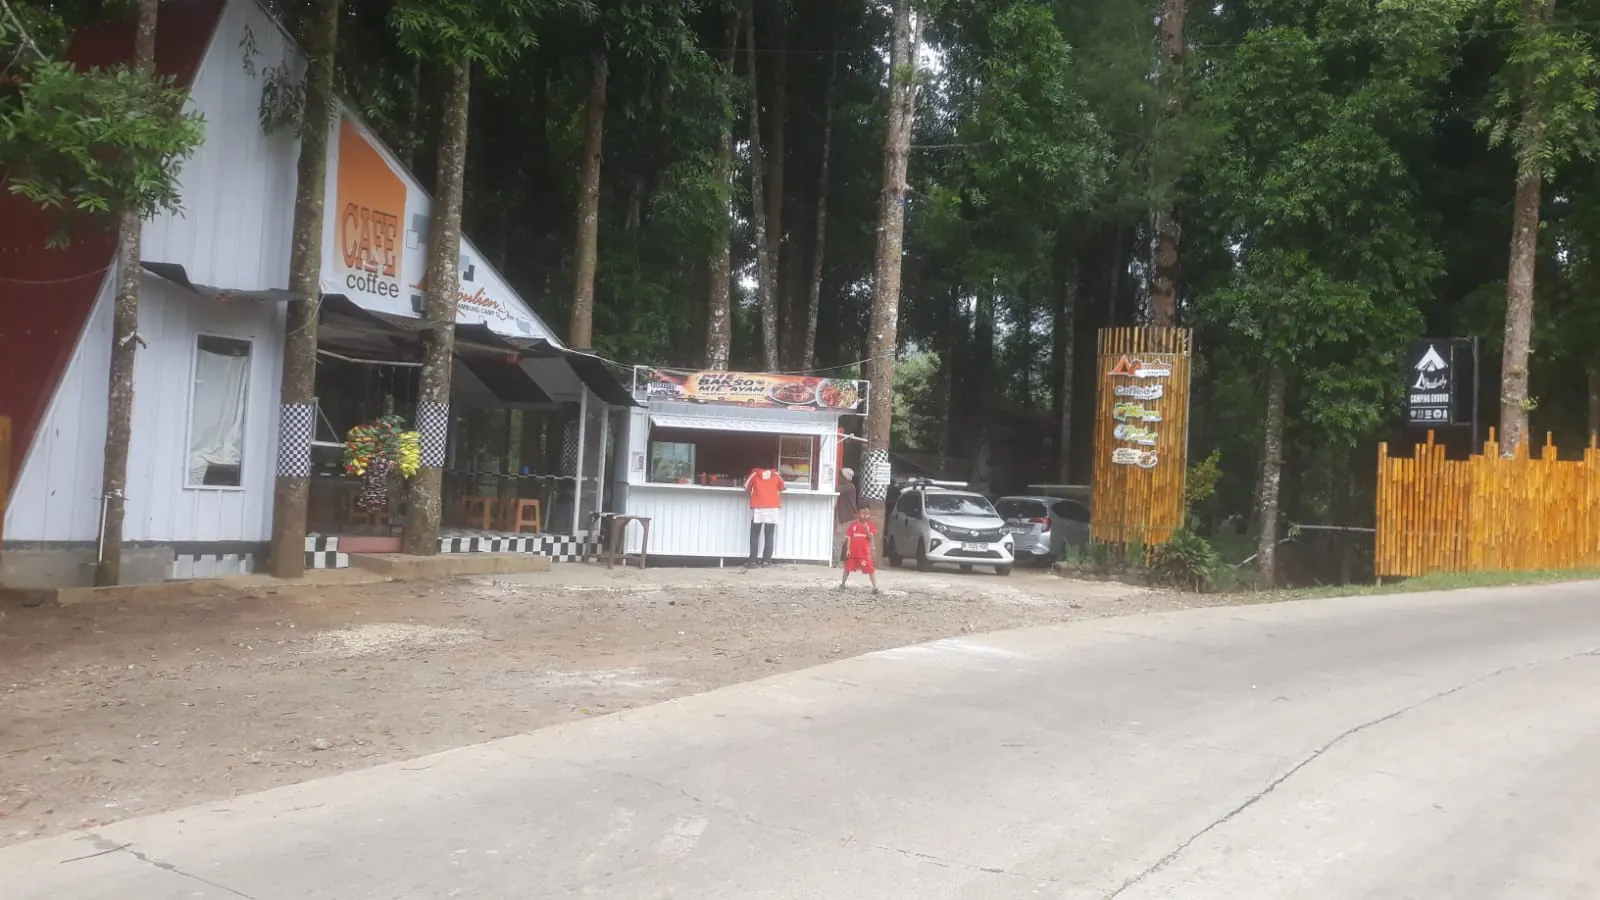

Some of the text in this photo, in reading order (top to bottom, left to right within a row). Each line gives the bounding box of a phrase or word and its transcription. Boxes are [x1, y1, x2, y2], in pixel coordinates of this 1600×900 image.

[342, 202, 397, 277] CAFE
[346, 273, 399, 298] coffee
[698, 378, 754, 386] BAKSO
[729, 385, 765, 393] AYAM
[1410, 393, 1449, 404] CAMPING GROUND
